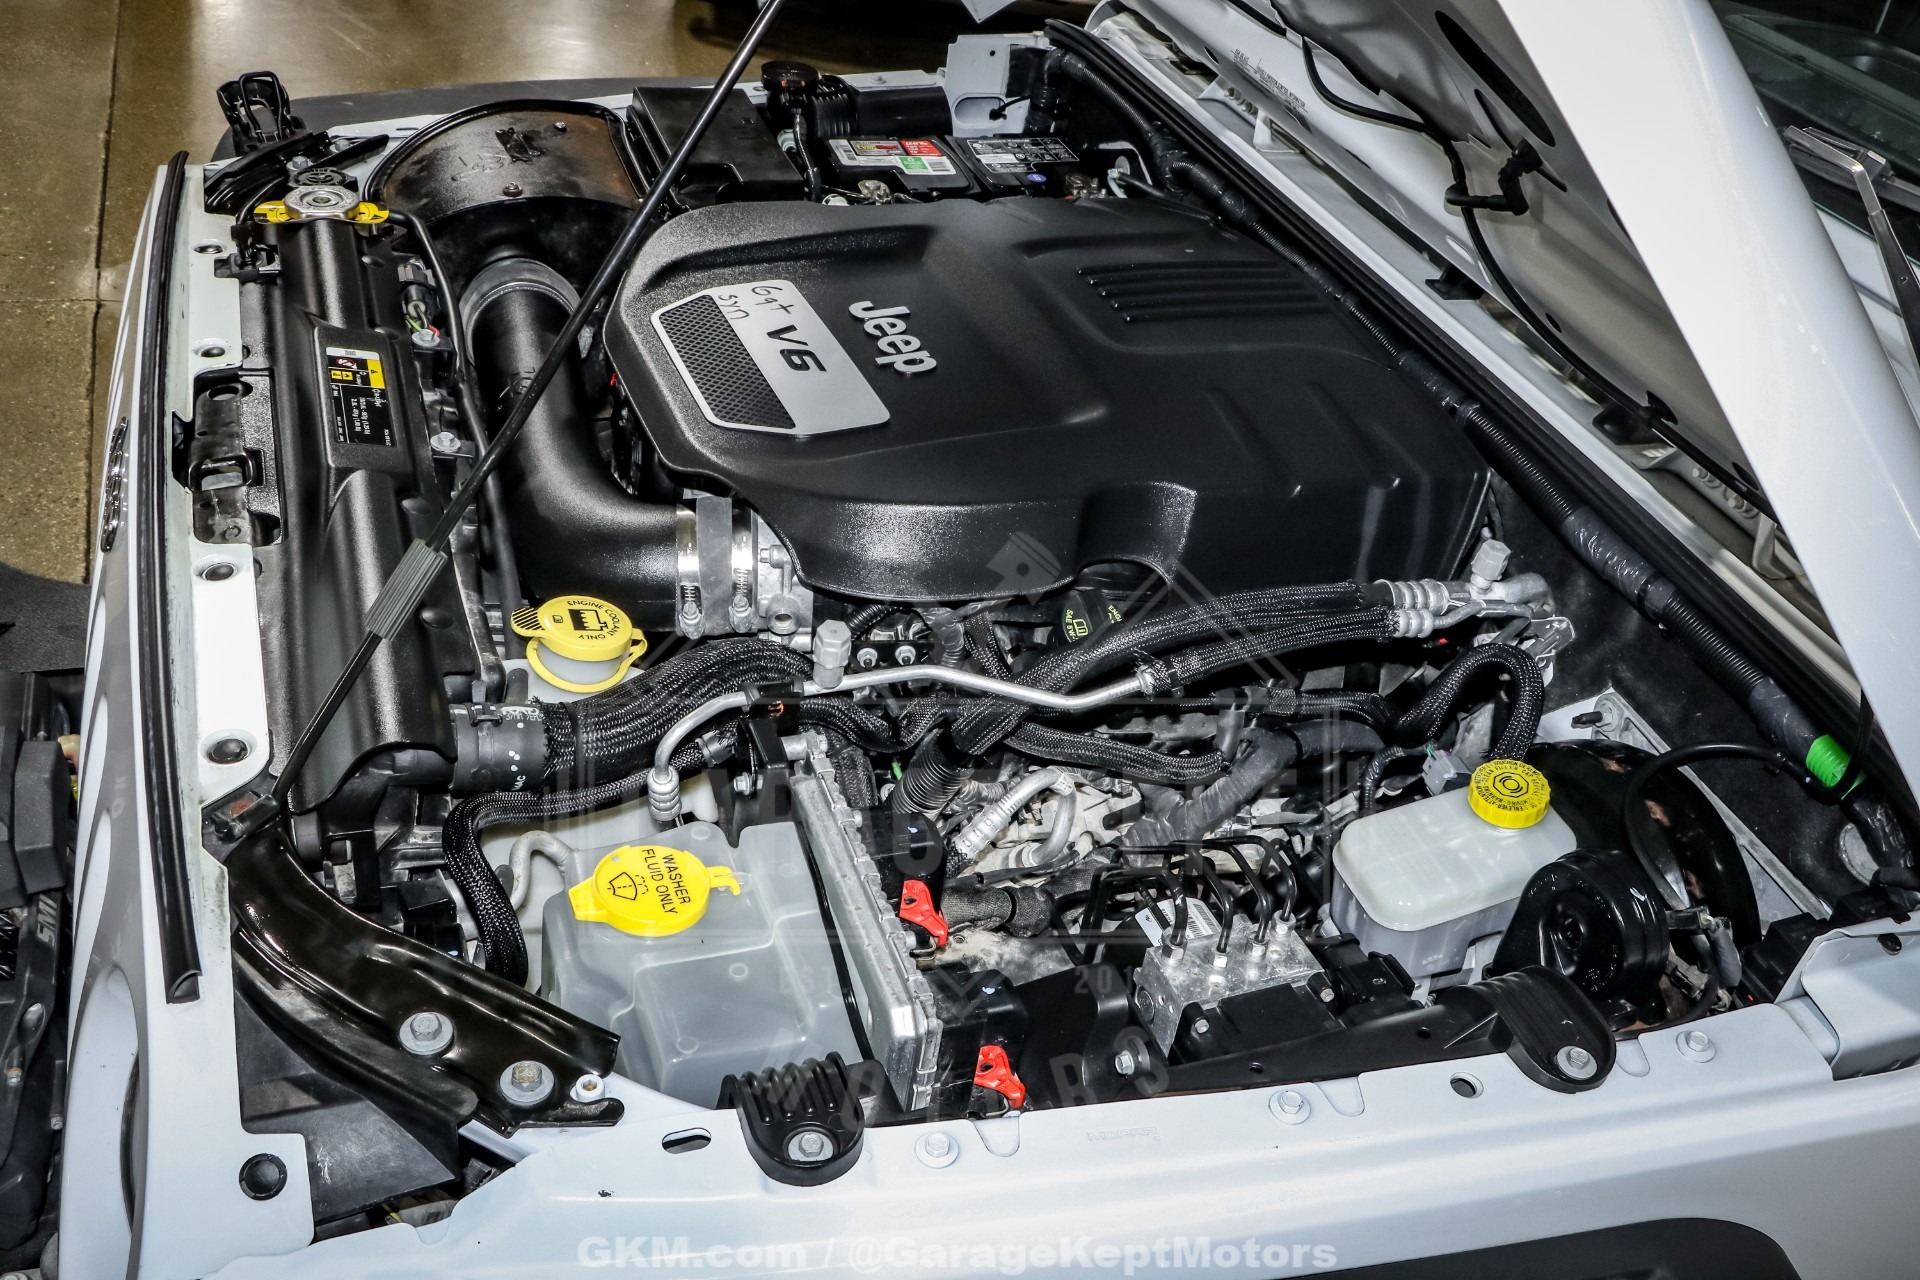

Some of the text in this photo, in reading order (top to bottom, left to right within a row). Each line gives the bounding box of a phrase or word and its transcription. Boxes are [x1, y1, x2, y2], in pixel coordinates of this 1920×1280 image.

[766, 324, 827, 372] V6
[849, 301, 937, 373] Jeep
[567, 600, 621, 636] ENGINE COOLANT
[1065, 609, 1074, 624] SAE
[642, 848, 678, 915] FLUID ONLY
[661, 854, 691, 905] WASHER
